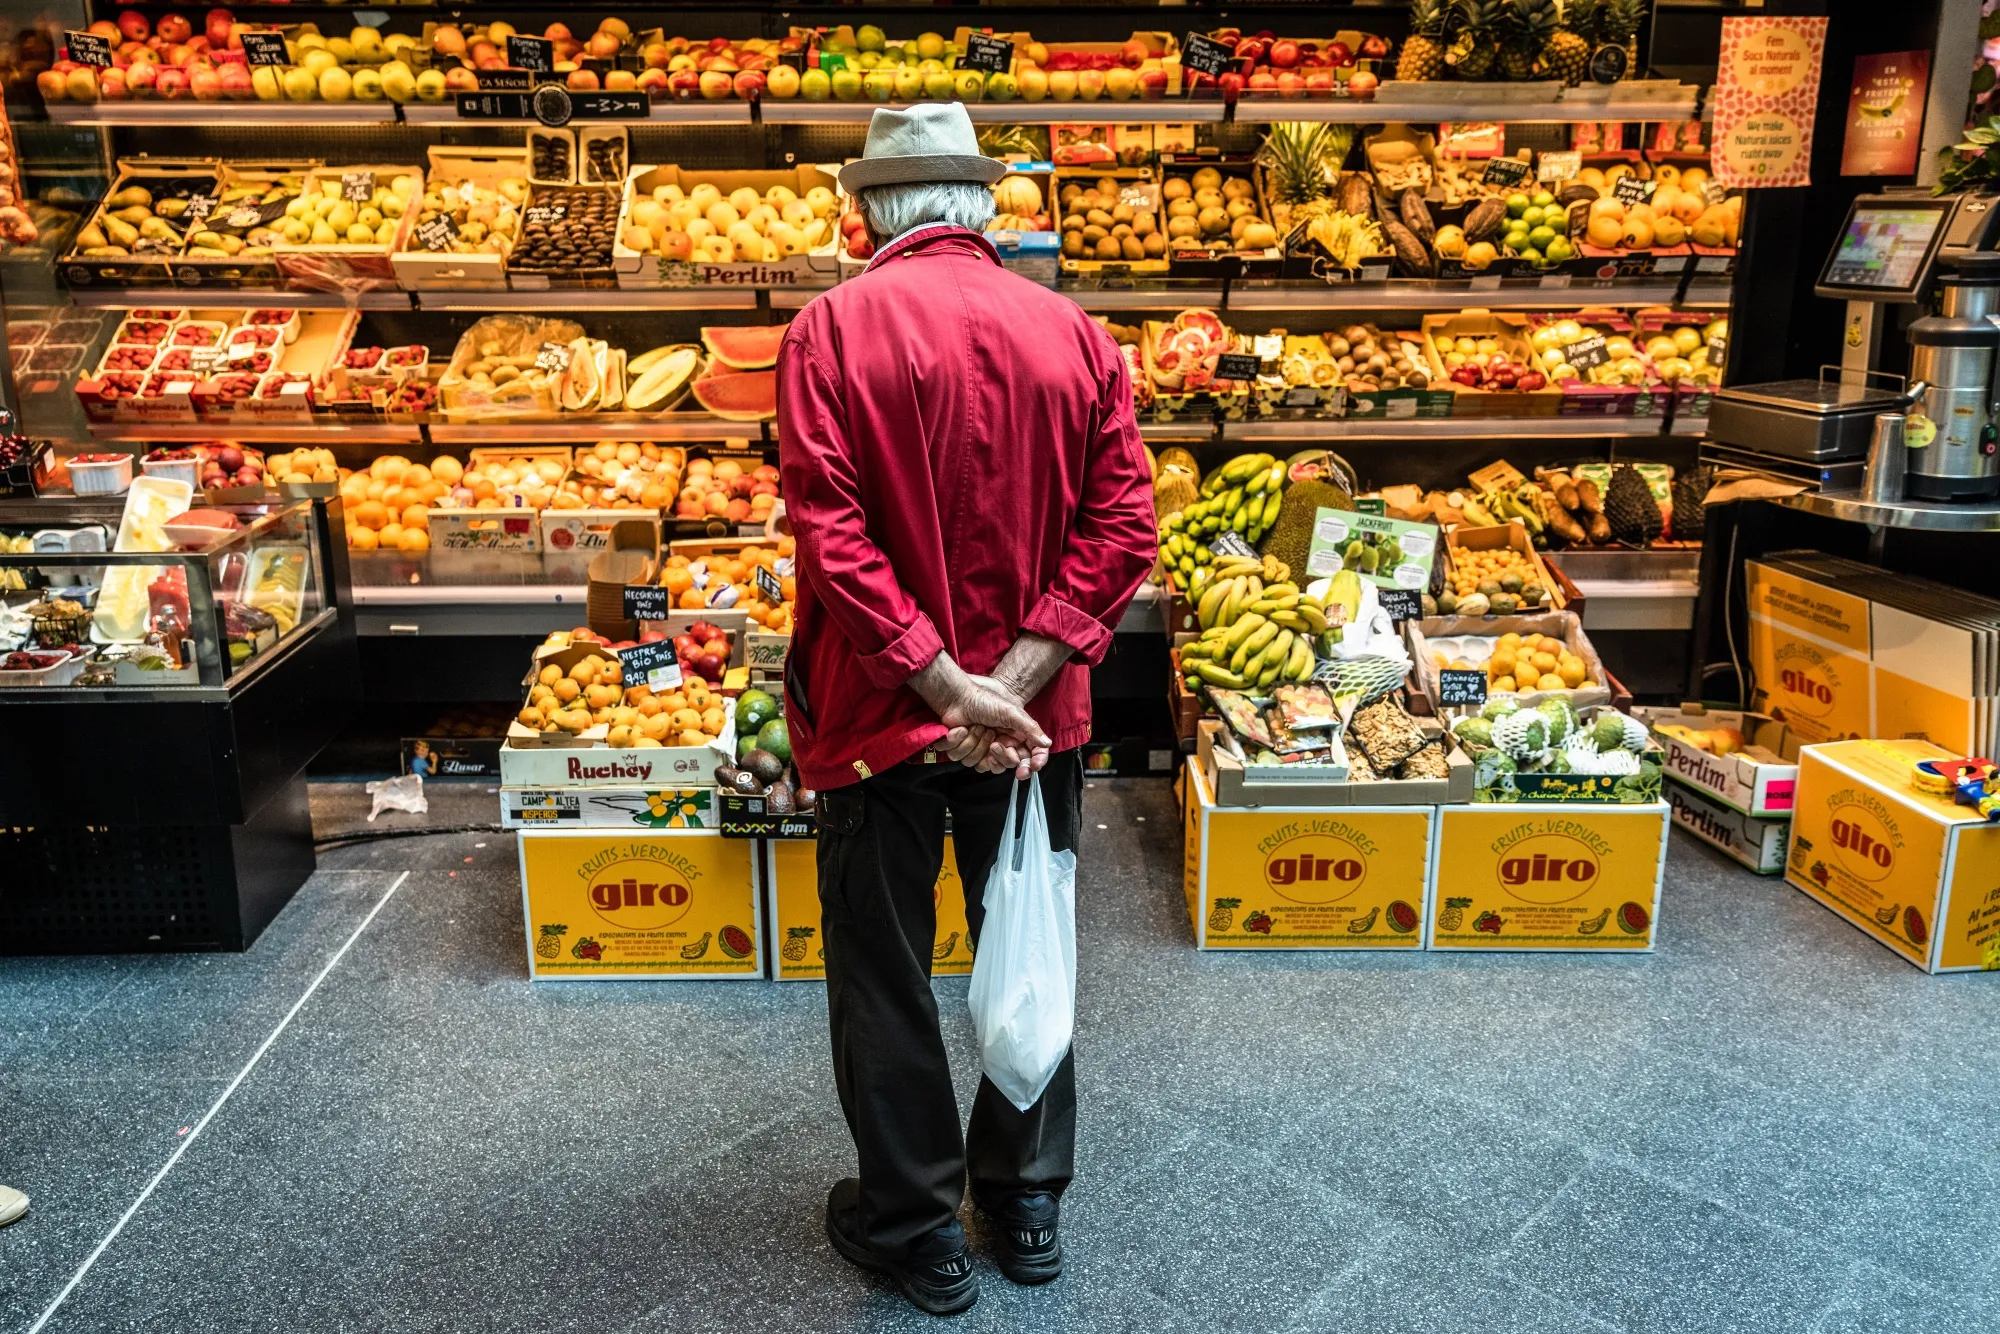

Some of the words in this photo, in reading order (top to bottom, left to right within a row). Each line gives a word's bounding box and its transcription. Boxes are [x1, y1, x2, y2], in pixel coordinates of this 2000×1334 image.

[1766, 36, 1785, 47] Fem
[1766, 50, 1800, 61] Naturals
[1750, 65, 1758, 75] al
[1759, 65, 1793, 75] moment
[1747, 121, 1761, 131] We
[1763, 121, 1784, 131] make
[1735, 135, 1767, 145] Natural
[1768, 134, 1792, 146] juices
[1740, 149, 1762, 160] right
[1763, 149, 1784, 159] away
[703, 266, 798, 285] Perlim
[1356, 517, 1394, 532] JACKFRUIT
[621, 646, 657, 661] NESPRE
[748, 650, 777, 665] Villa
[1781, 669, 1833, 705] giro
[1667, 743, 1727, 793] Perlim
[556, 796, 580, 806] ALTEA
[1765, 791, 1793, 800] ROSE
[780, 819, 808, 835] ipm
[1671, 791, 1732, 848] Perlim
[1827, 789, 1855, 811] FRUITS
[1861, 791, 1906, 849] VERDURES
[1257, 822, 1300, 856] FRUITS
[1311, 819, 1380, 857] VERDURES
[1490, 821, 1534, 856] FRUITS
[1546, 819, 1614, 857] VERDURES
[1831, 819, 1892, 868] giro
[577, 846, 619, 881] FRUITS
[630, 843, 703, 881] VERDURES
[1268, 853, 1363, 885] giro
[1501, 853, 1596, 886] giro
[591, 878, 689, 912] giro
